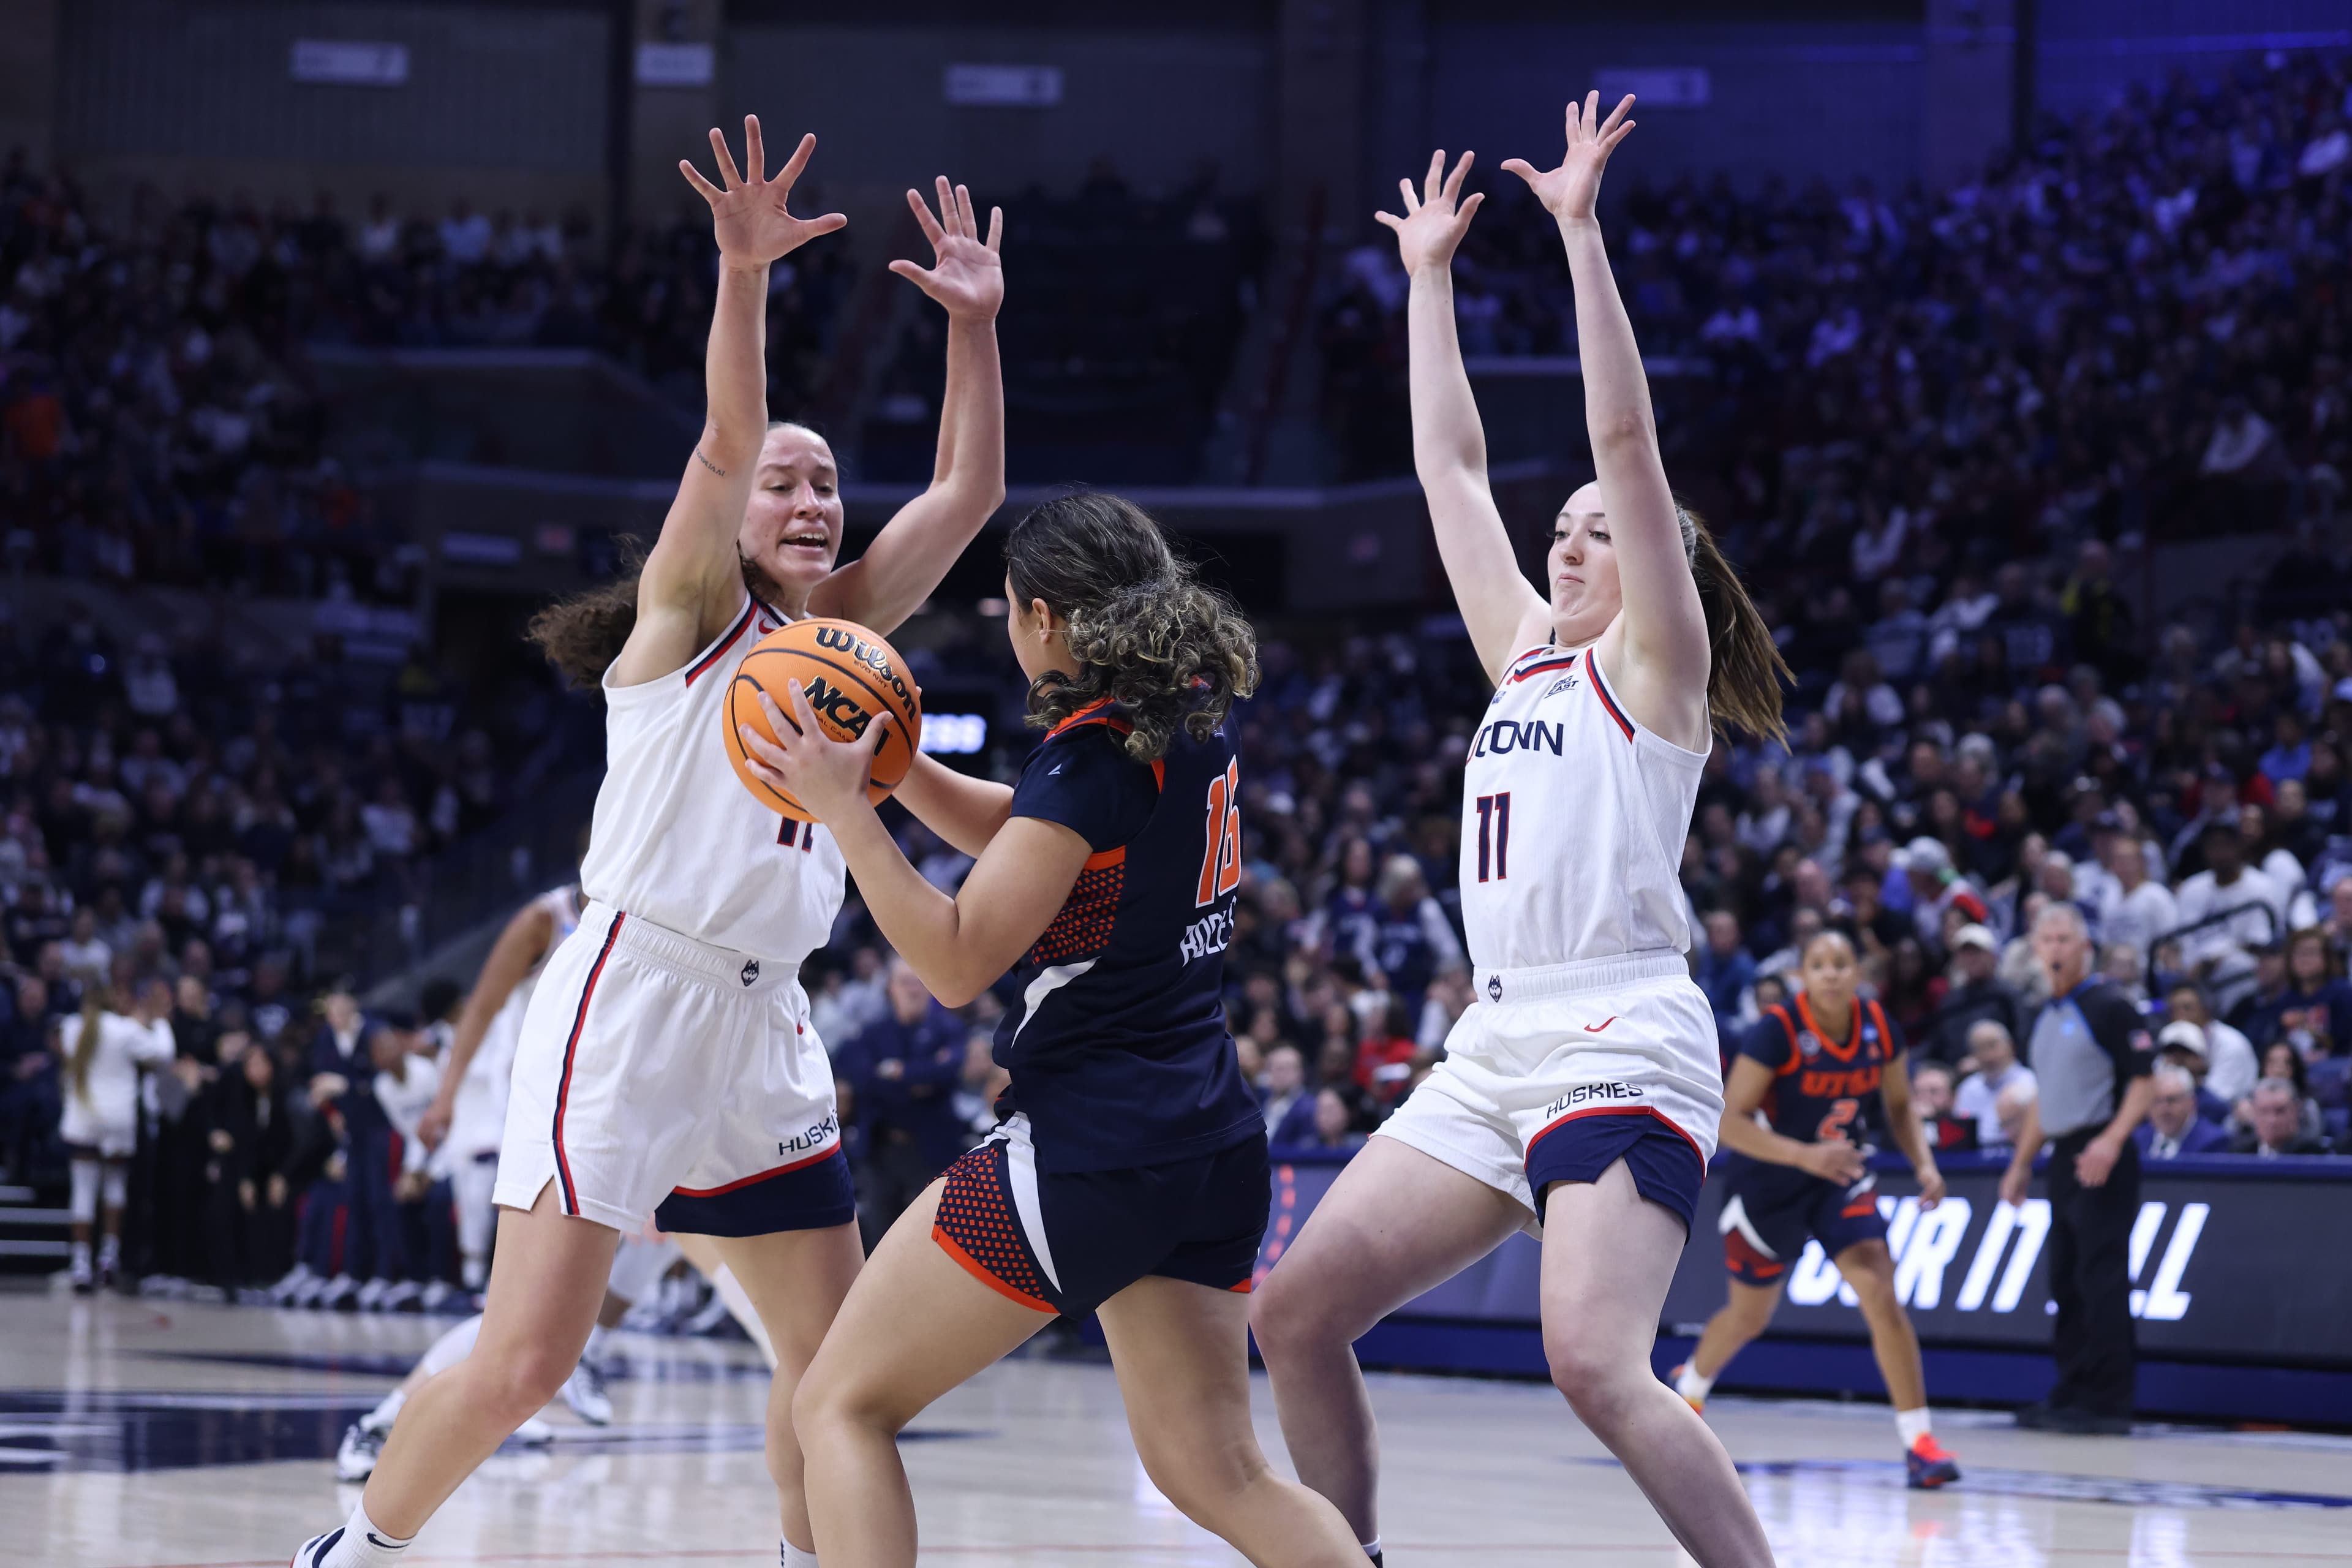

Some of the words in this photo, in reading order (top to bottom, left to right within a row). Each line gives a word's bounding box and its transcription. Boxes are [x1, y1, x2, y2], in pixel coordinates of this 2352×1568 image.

[872, 673, 888, 688] NXT
[1547, 680, 1580, 696] EAST
[1553, 675, 1574, 689] BIG
[1468, 720, 1564, 758] CONN
[1477, 791, 1511, 883] 11
[1547, 1082, 1645, 1119] HUSKIES
[778, 1109, 838, 1156] HUSKI
